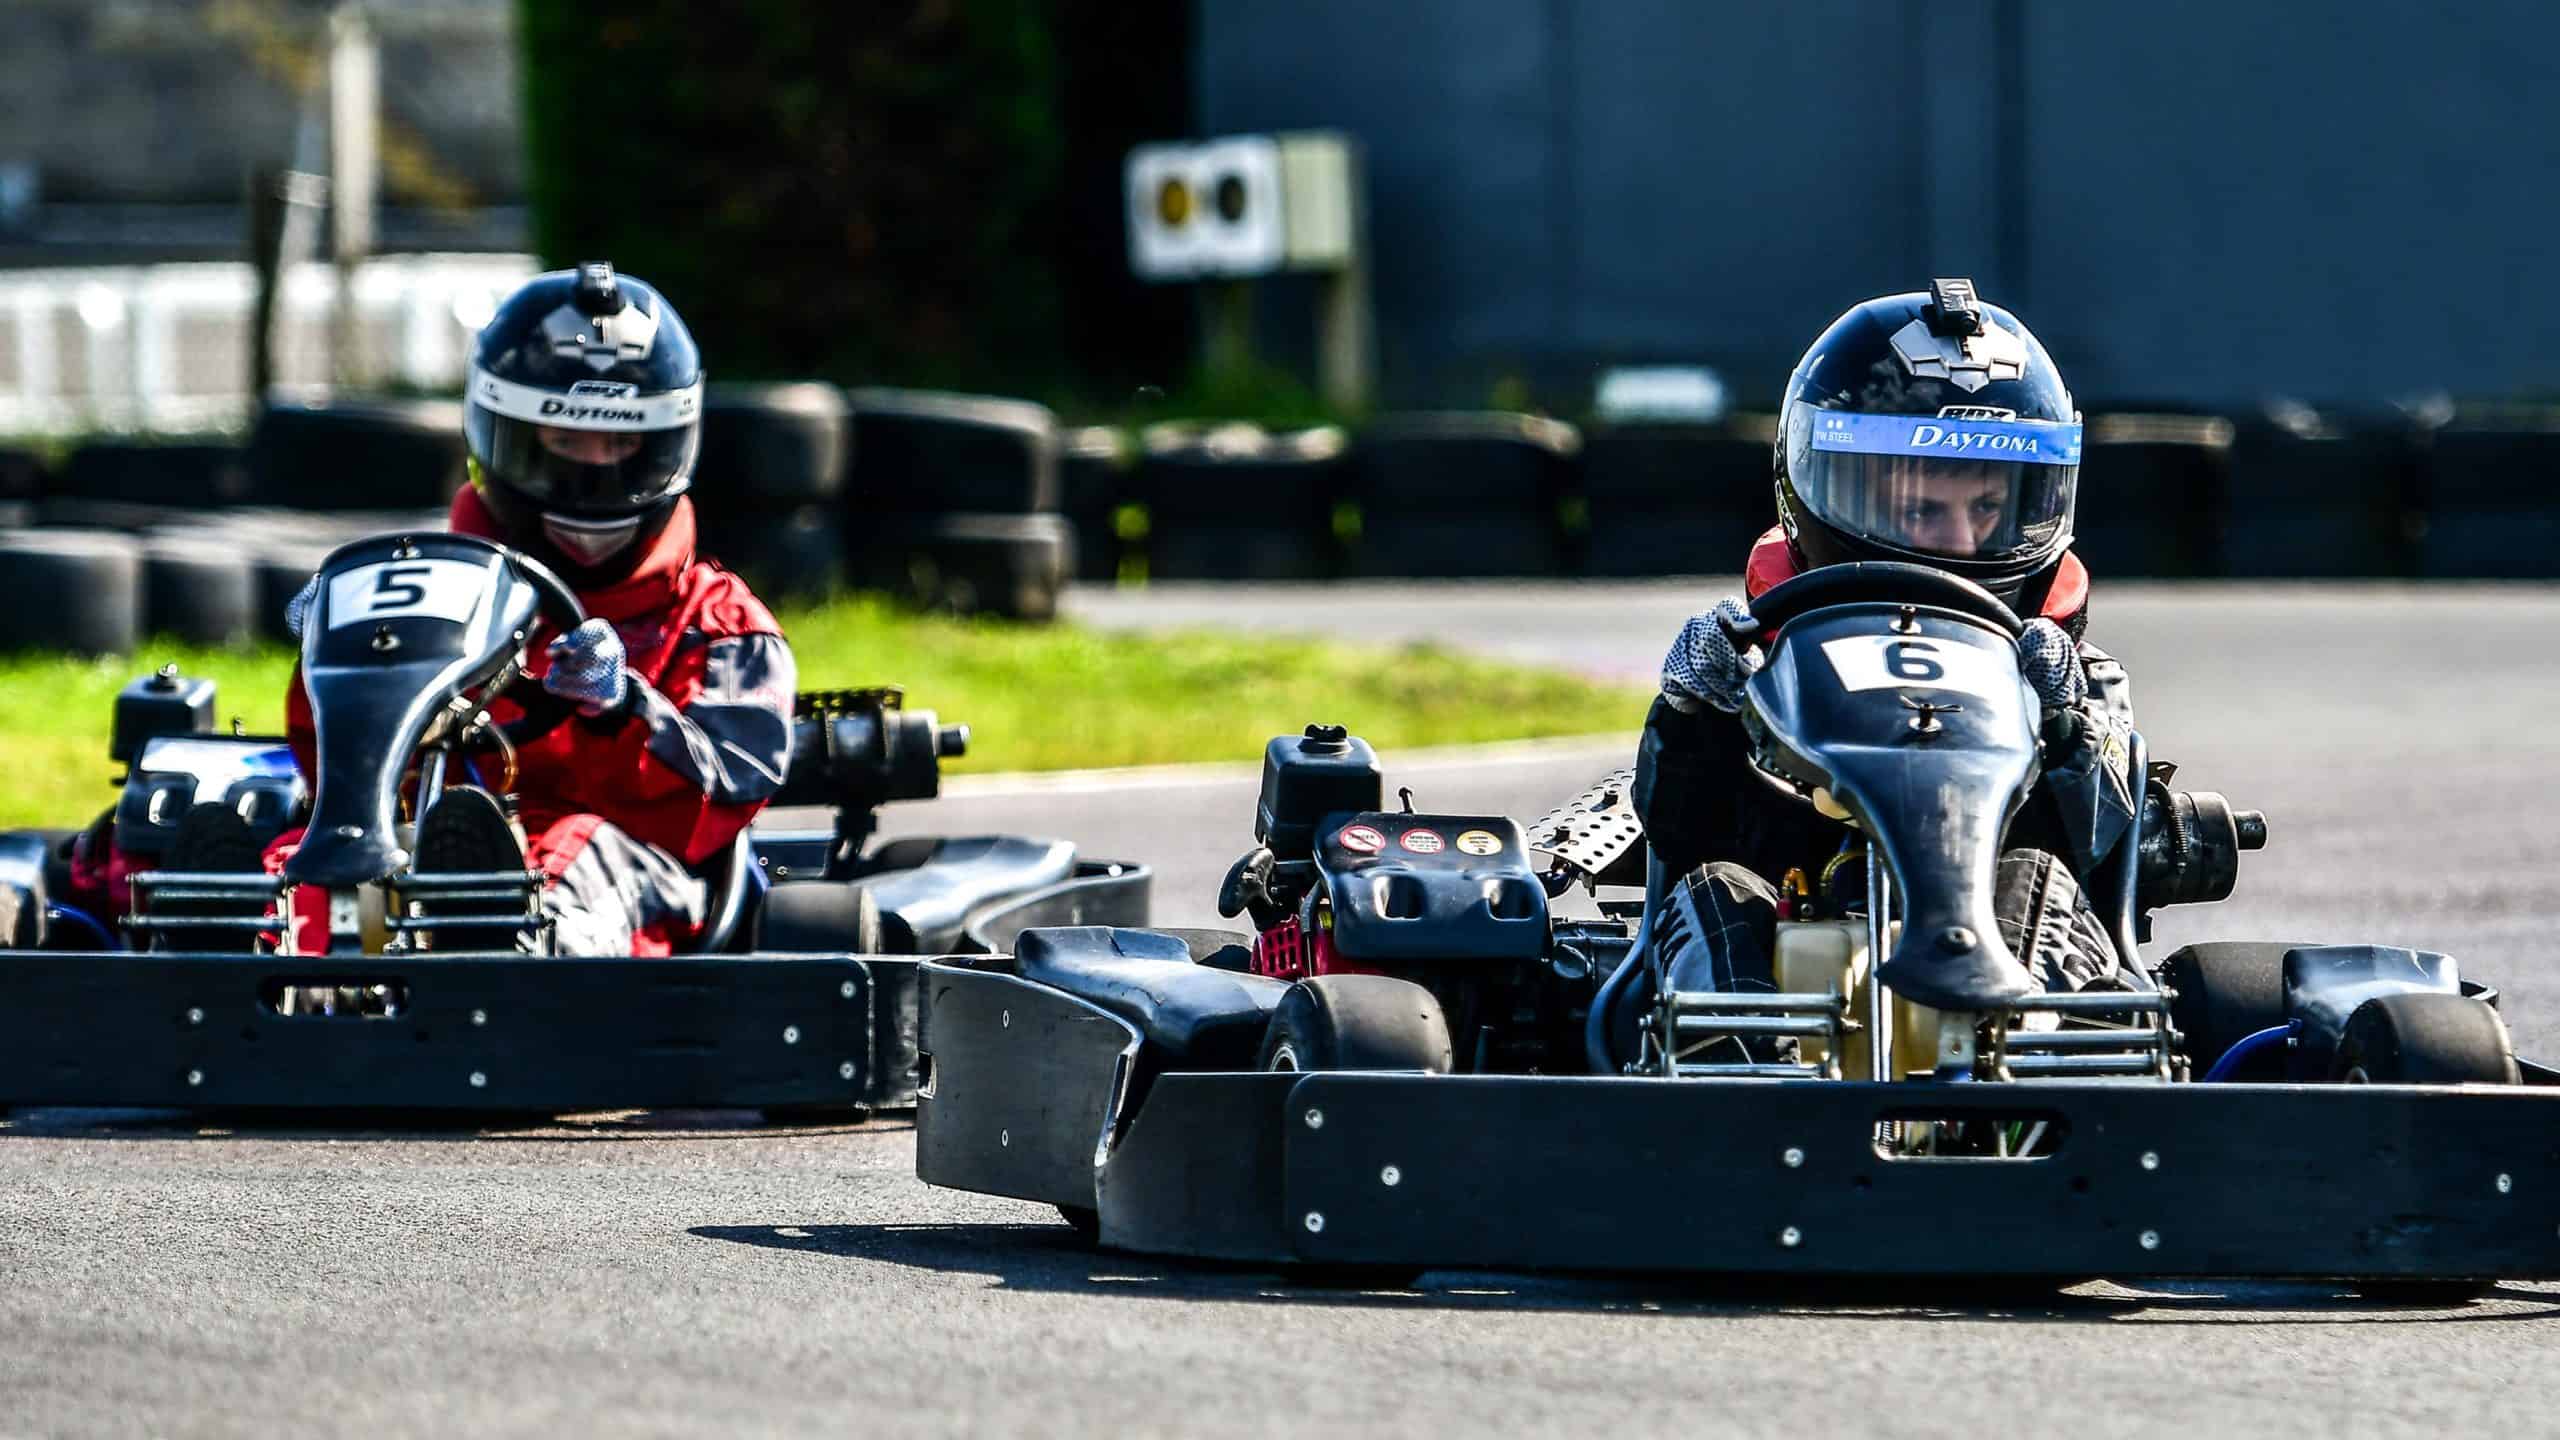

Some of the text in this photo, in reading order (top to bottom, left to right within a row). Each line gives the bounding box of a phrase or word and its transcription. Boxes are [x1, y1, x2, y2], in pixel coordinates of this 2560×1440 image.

[541, 400, 644, 421] DAYTONA
[1911, 424, 2038, 454] DAYTONA
[371, 567, 432, 611] 5
[1885, 641, 1944, 681] 6
